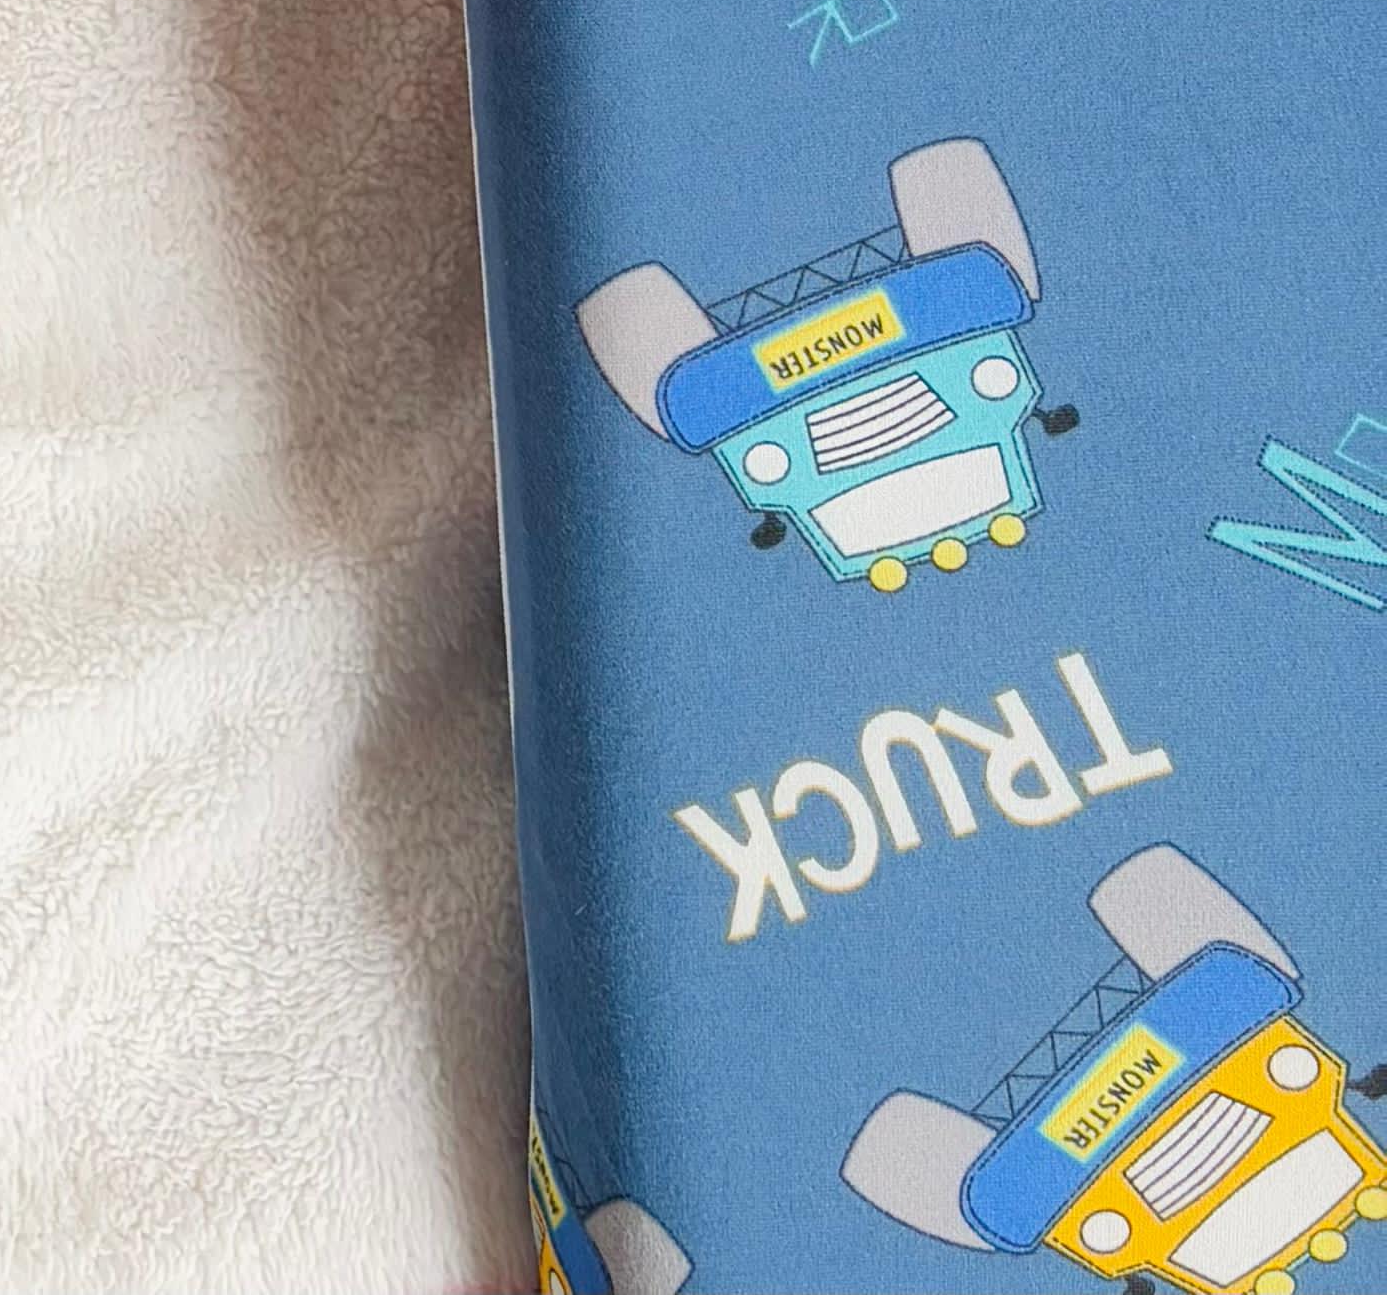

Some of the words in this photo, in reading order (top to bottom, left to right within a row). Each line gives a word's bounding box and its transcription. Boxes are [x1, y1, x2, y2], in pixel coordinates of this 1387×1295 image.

[769, 312, 885, 381] MONSTER
[673, 652, 1175, 944] TRUCK
[1062, 1048, 1164, 1151] MONSTER
